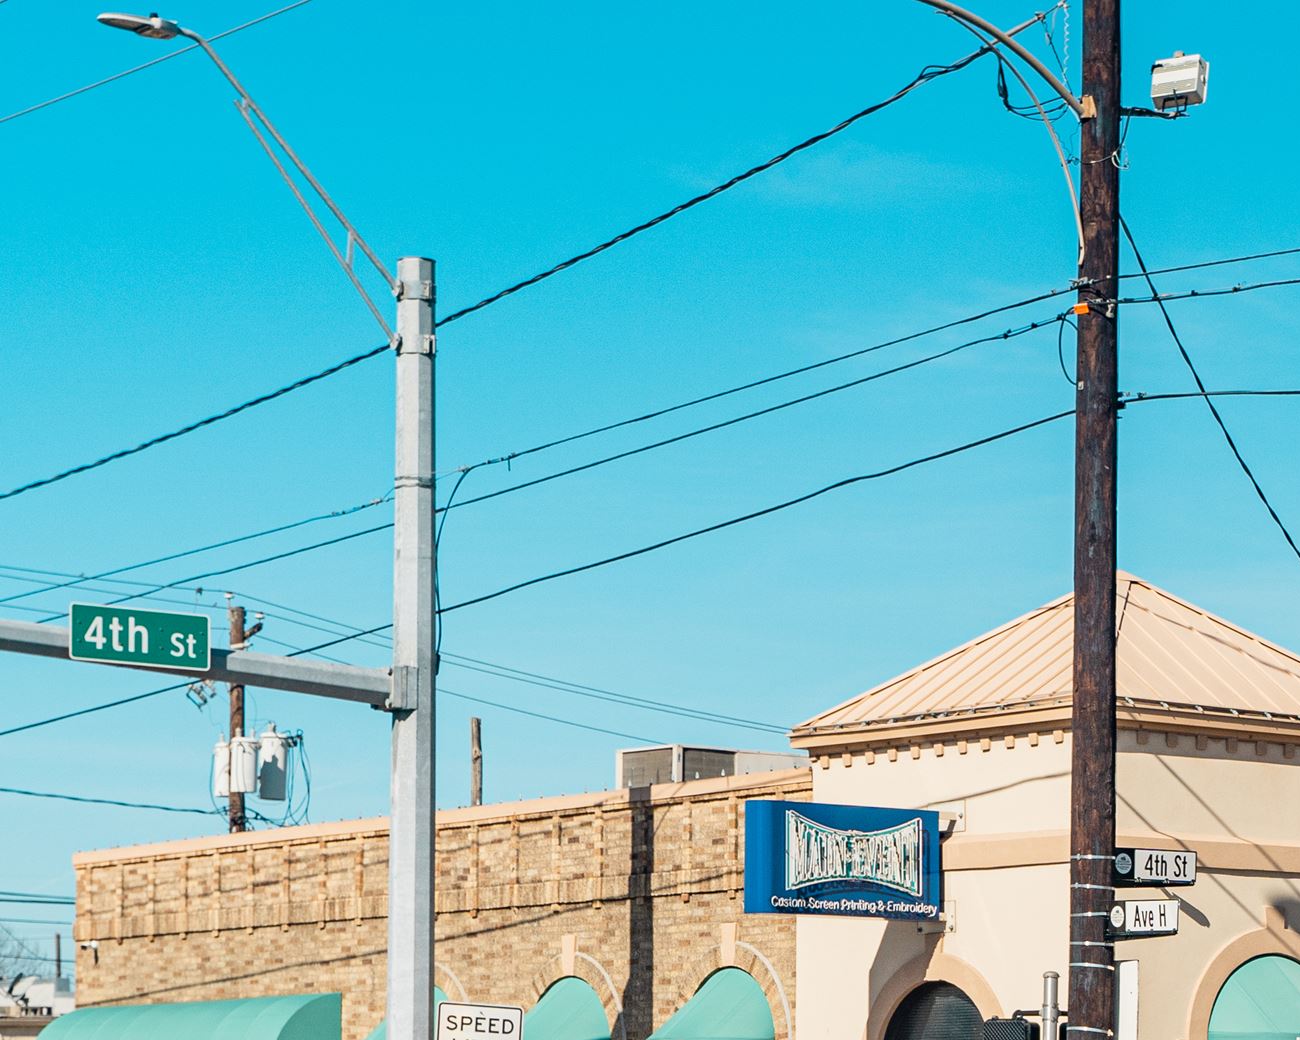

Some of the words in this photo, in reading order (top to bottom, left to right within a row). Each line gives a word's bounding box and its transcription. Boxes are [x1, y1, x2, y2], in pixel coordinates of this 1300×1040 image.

[84, 616, 148, 654] 4th
[170, 632, 197, 659] St
[1144, 853, 1168, 877] 4th
[1173, 854, 1188, 878] St
[771, 895, 806, 908] Custom
[808, 896, 840, 910] Screen
[841, 899, 876, 914] Printing
[877, 900, 886, 912] &
[887, 901, 937, 918] Embroidery
[1133, 905, 1154, 928] Ave
[1158, 903, 1167, 927] H
[446, 1014, 515, 1035] SPEED
